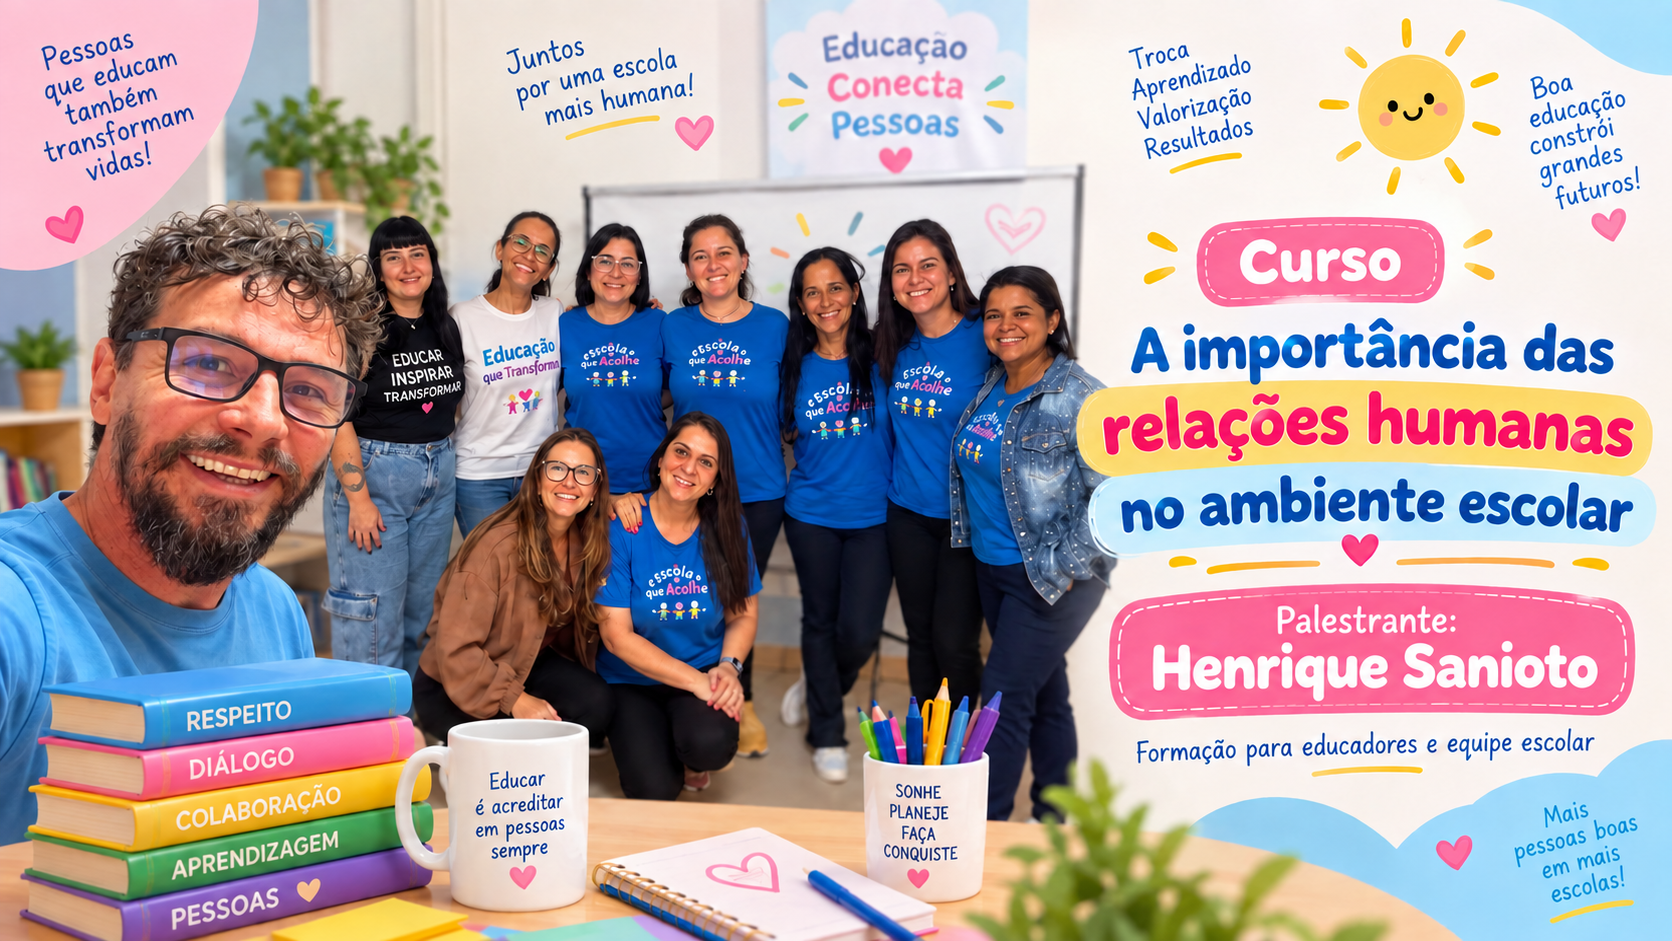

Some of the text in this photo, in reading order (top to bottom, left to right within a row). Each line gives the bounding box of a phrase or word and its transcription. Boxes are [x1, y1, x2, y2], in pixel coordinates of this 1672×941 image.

[823, 31, 968, 65] Educação
[827, 71, 964, 102] Conecta
[831, 110, 960, 140] Pessoas
[392, 349, 444, 368] EDUCAR
[482, 338, 556, 367] Educação
[599, 354, 640, 366] Acolhe
[688, 353, 751, 367] que Acolhe
[391, 365, 454, 387] INSPIRAR
[483, 371, 503, 385] que
[383, 380, 462, 403] TRANSFORMAR
[910, 379, 953, 396] Acolhe
[805, 407, 825, 420] que
[645, 580, 708, 600] que Acolhe
[186, 700, 292, 731] RESPEITO
[189, 746, 295, 780] DIÁLOGO
[489, 771, 545, 790] Educar
[895, 783, 942, 799] SONHE
[176, 784, 342, 831] COLABORAÇÃO
[475, 793, 564, 815] é acreditar
[890, 803, 949, 821] PLANEJE
[475, 818, 565, 842] em pessoas
[901, 825, 936, 844] FAÇA
[171, 831, 340, 881] APRENDIZAGEM
[491, 842, 548, 863] sempre
[884, 844, 958, 862] CONQUISTE
[171, 887, 280, 931] PESSOAS
